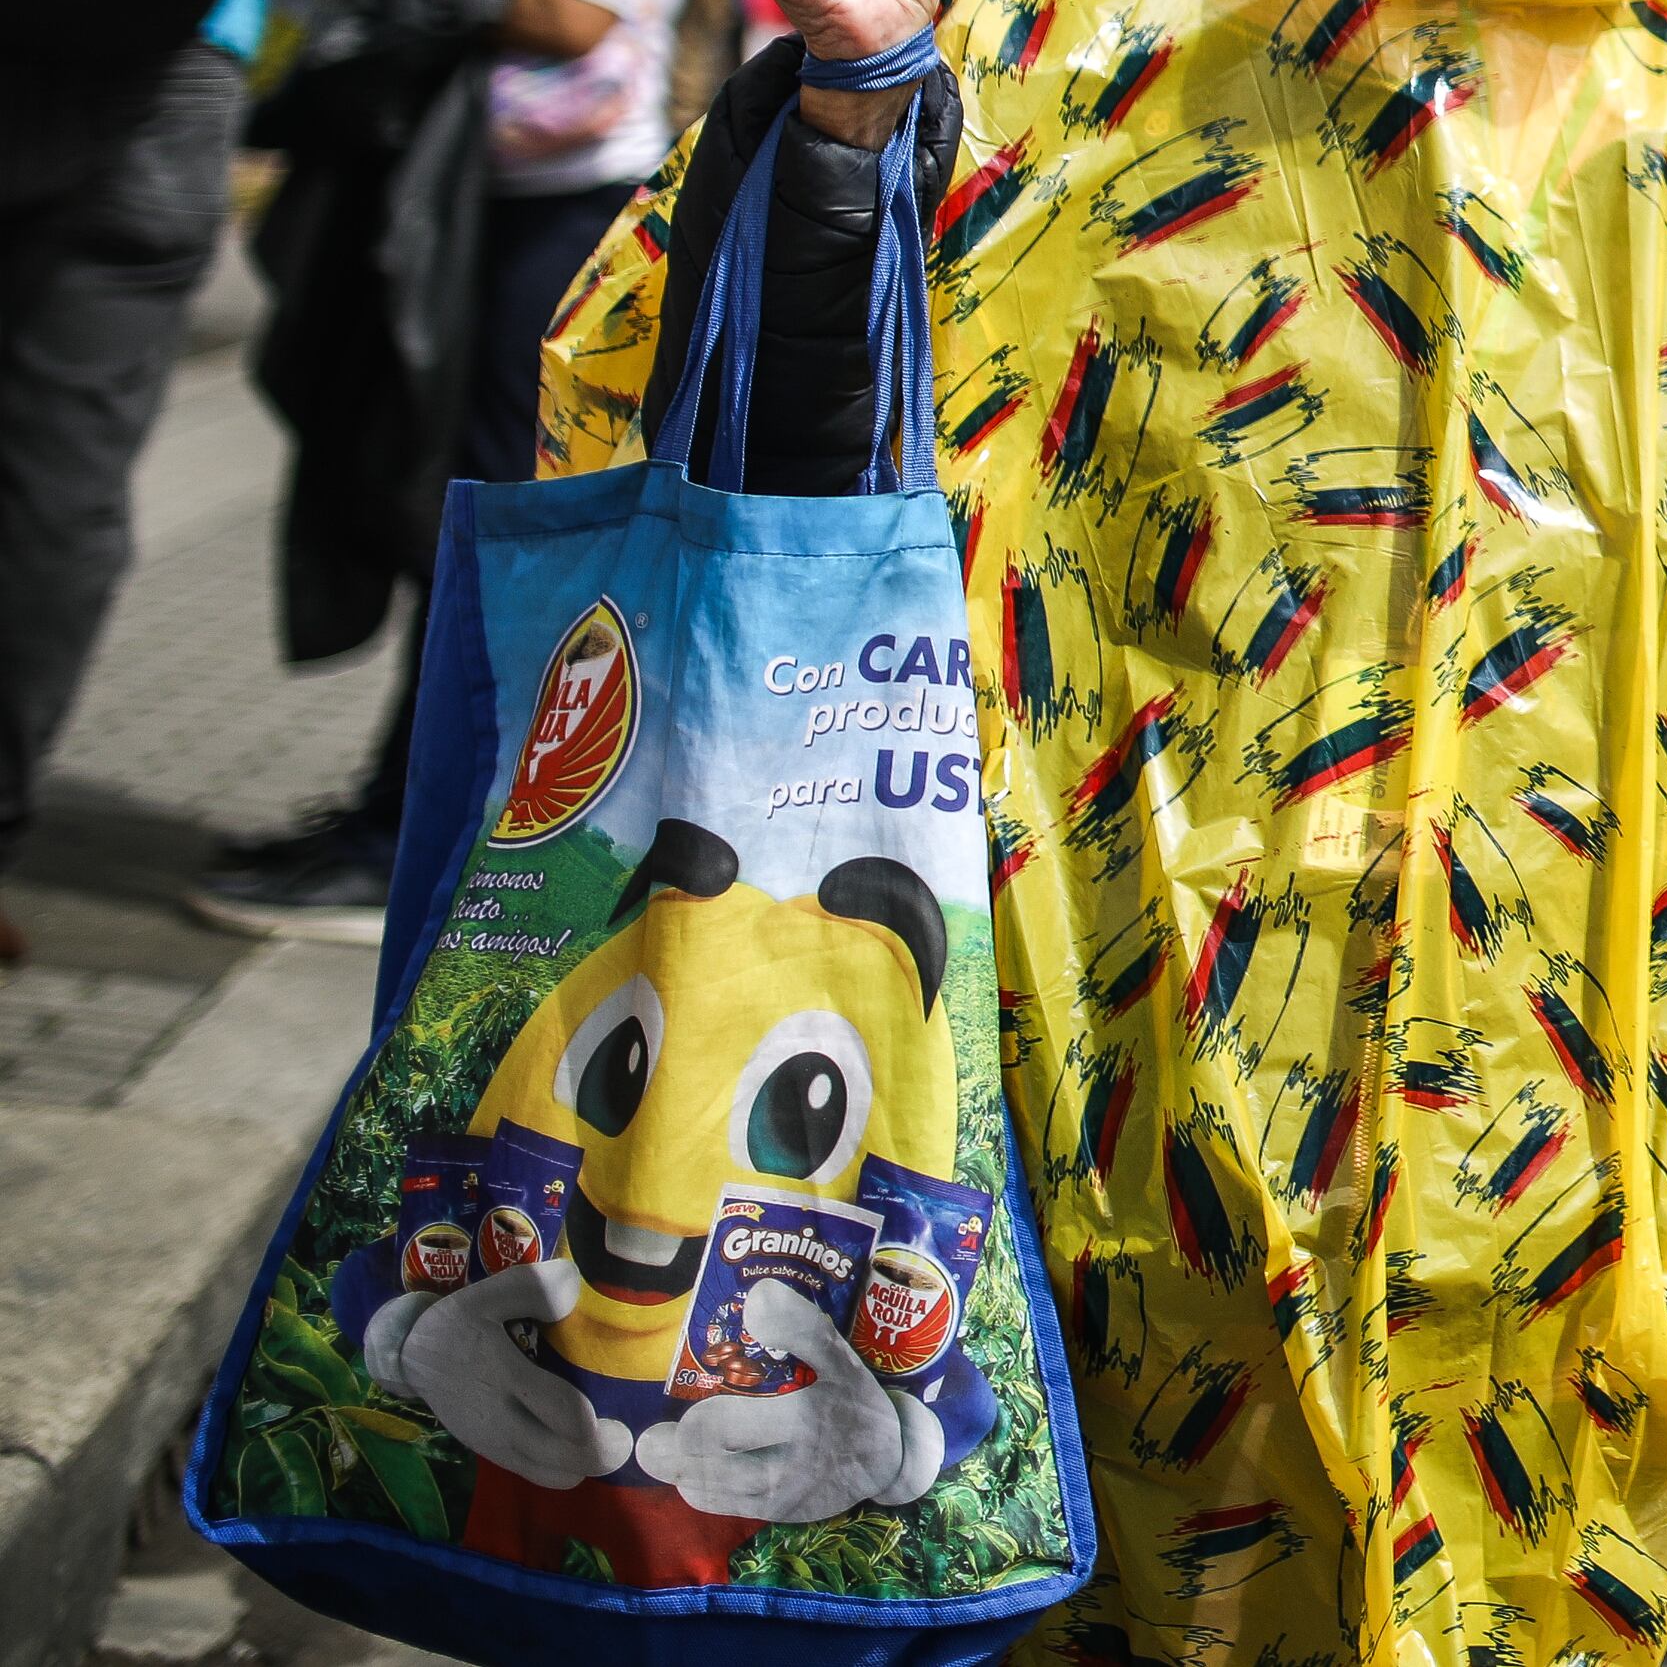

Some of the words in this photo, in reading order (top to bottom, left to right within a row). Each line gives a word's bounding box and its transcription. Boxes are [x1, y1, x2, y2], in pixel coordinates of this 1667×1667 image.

[764, 655, 846, 696] Con
[767, 778, 862, 820] para
[470, 928, 572, 964] amigos!
[722, 1204, 757, 1217] NUEVO
[723, 1227, 854, 1279] Graninos
[742, 1265, 770, 1278] Dulce
[771, 1265, 797, 1278] sabor
[866, 1281, 927, 1315] AGUILA
[871, 1300, 913, 1329] ROJA
[676, 1369, 699, 1385] 50
